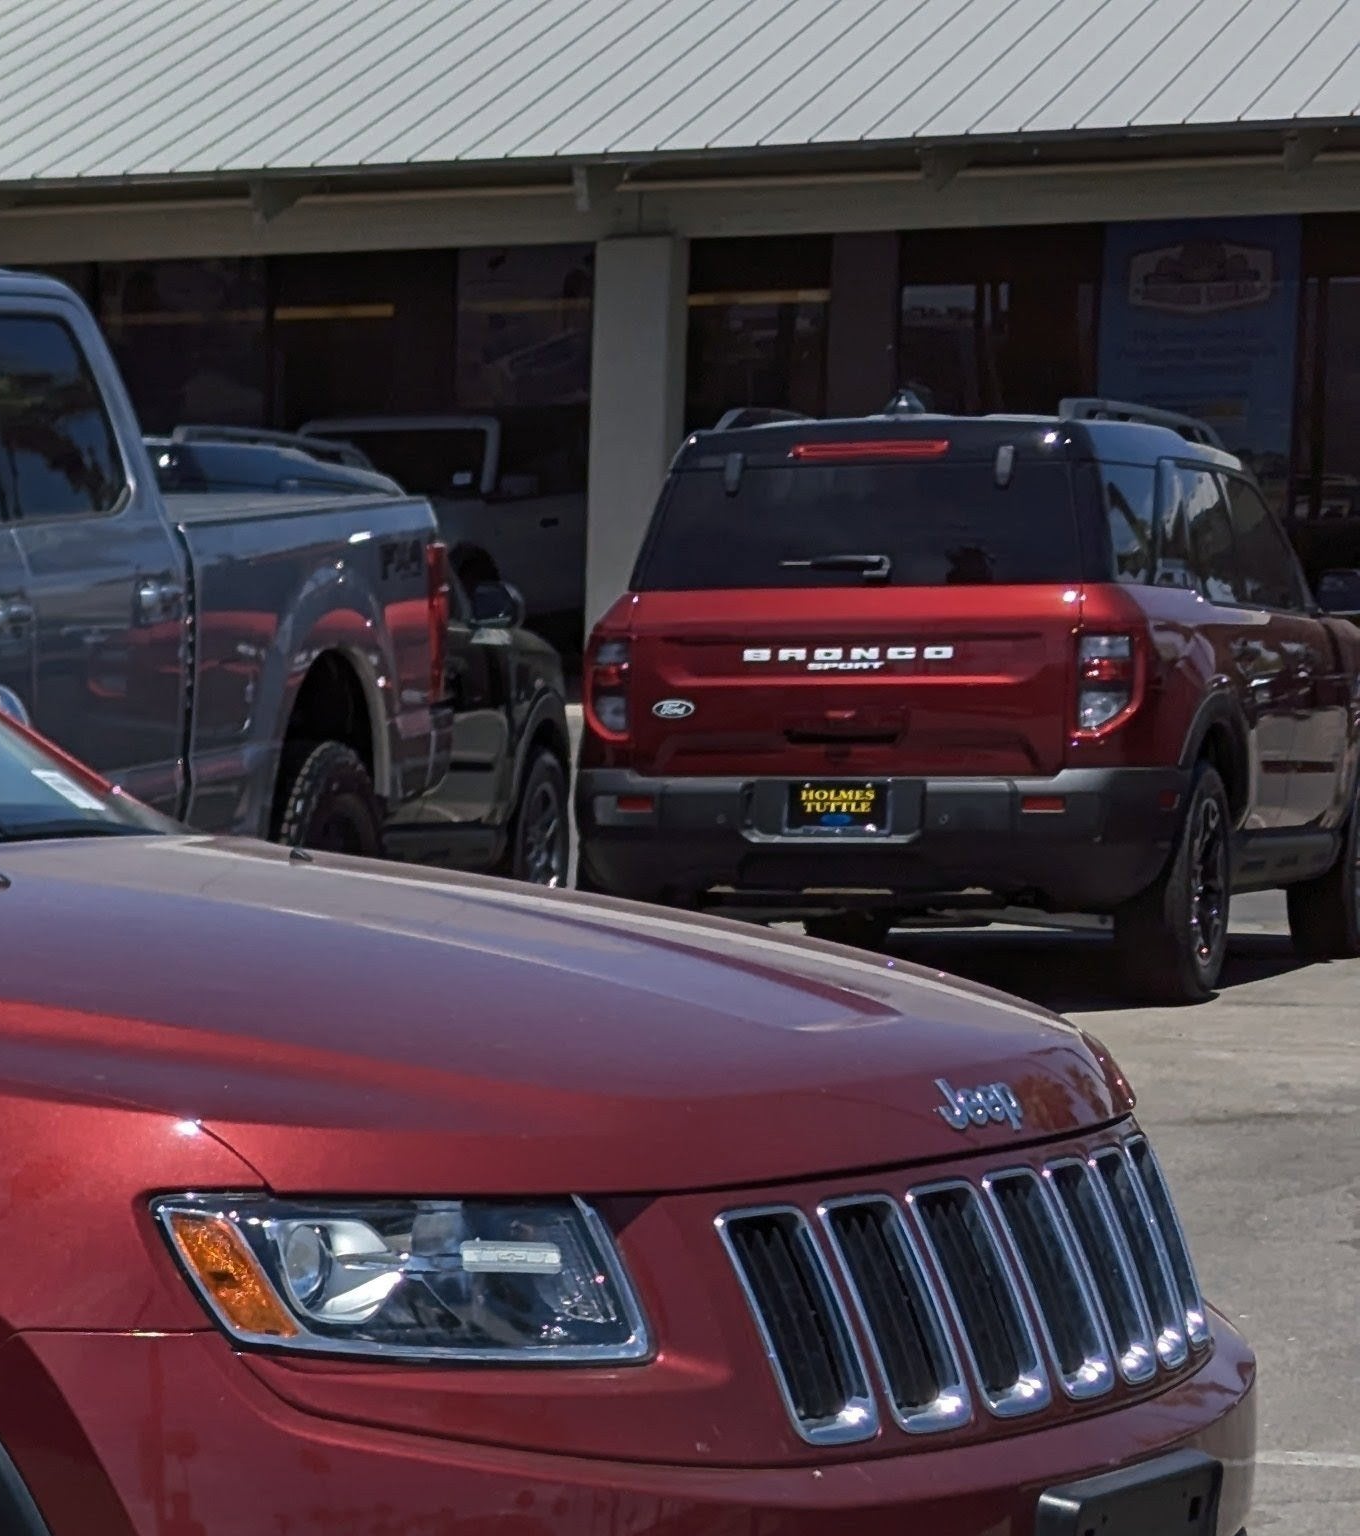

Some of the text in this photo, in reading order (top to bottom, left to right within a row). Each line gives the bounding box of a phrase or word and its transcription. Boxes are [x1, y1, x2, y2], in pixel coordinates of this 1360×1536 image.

[743, 646, 954, 662] BRONCO
[807, 661, 884, 670] SPORT
[800, 788, 876, 801] HOLMES
[803, 801, 872, 813] TUTTLE
[934, 1078, 1023, 1130] Jeep
